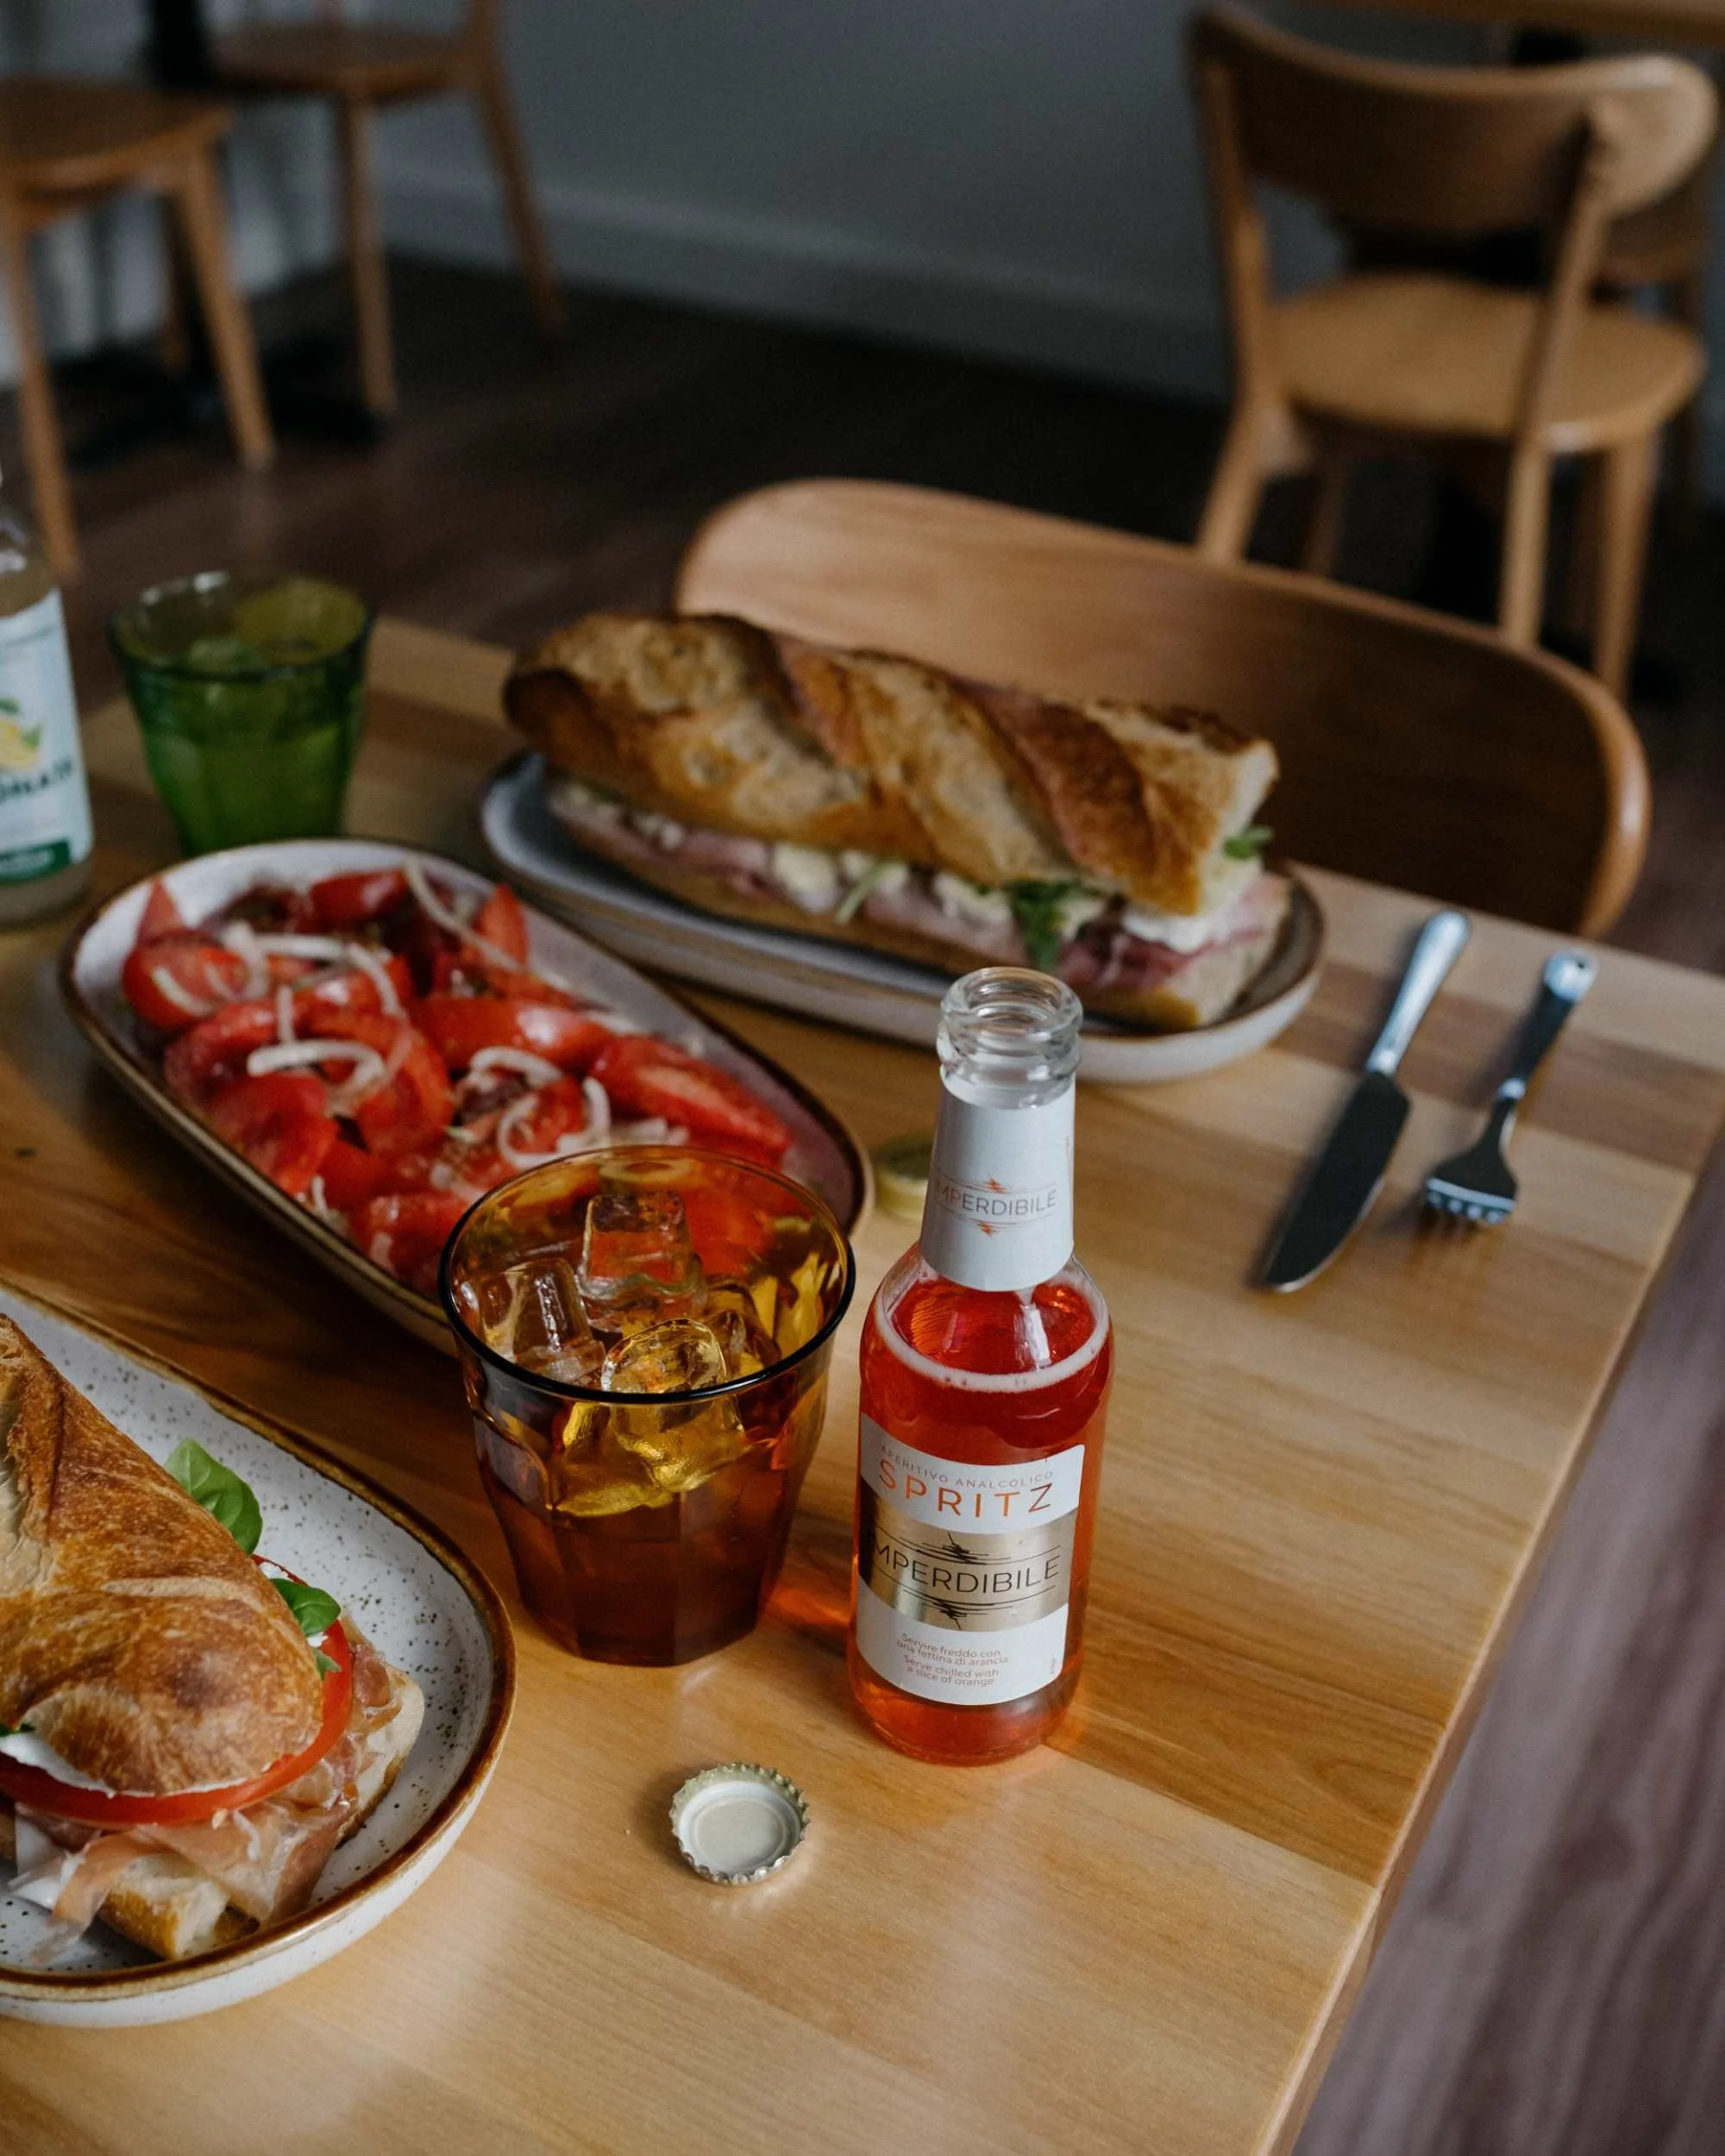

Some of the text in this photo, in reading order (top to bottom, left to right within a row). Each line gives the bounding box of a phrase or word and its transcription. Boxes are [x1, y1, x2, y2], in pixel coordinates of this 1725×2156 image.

[881, 1445, 1053, 1489] APERITIVO ANALCOLICO
[879, 1459, 1053, 1518] SPRITZ
[872, 1535, 1061, 1594] MPERDIBILE
[897, 1640, 1008, 1666] una fettina di arancia
[902, 1633, 1000, 1658] Servire freddo con
[903, 1653, 999, 1678] Serve chilled with
[916, 1669, 938, 1681] slice
[940, 1676, 952, 1684] of
[955, 1677, 994, 1688] orange
